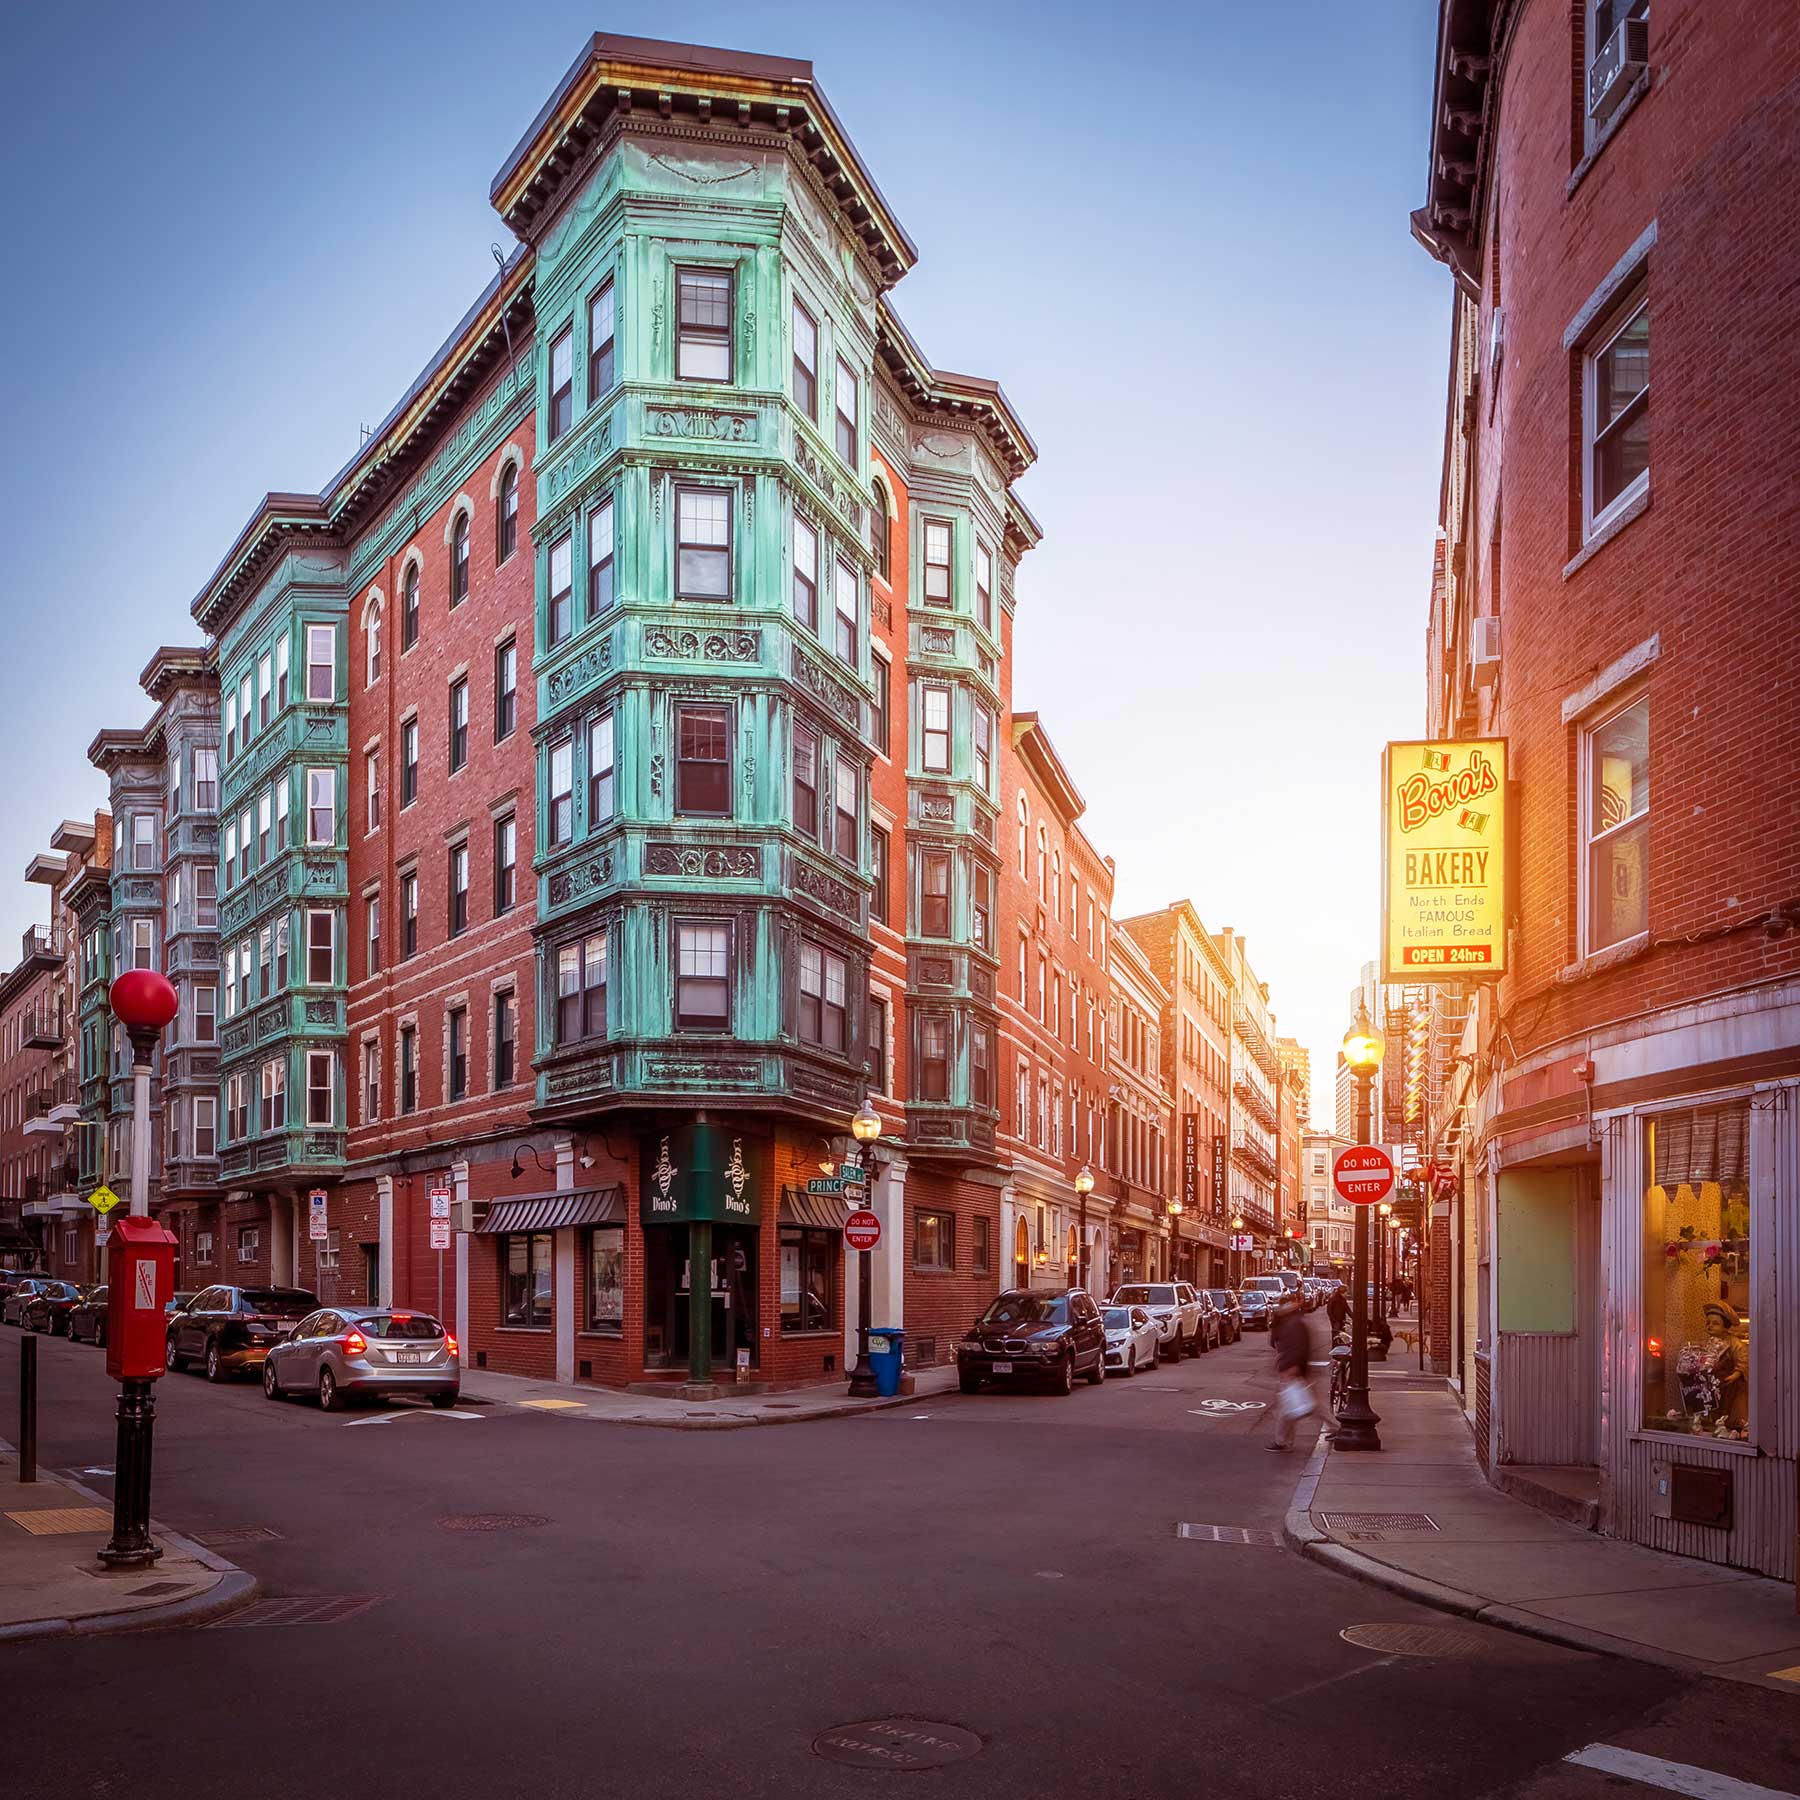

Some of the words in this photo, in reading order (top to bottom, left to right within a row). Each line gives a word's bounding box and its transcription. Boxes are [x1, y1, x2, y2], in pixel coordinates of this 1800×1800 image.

[1399, 751, 1497, 832] Bova's
[1406, 851, 1488, 885] BAKERY
[1409, 896, 1447, 907] North
[1402, 925, 1444, 938] Italian
[1453, 924, 1492, 936] Bread
[1411, 948, 1445, 963] OPEN
[1450, 948, 1485, 962] 24hrs
[1186, 1117, 1195, 1202] LIBERTINE
[1343, 1158, 1357, 1168] DO
[1362, 1157, 1382, 1167] NOT
[1214, 1139, 1223, 1215] LIBERTINE
[1347, 1182, 1381, 1193] ENTER
[653, 1197, 677, 1212] Dino's
[726, 1195, 749, 1214] Dino's
